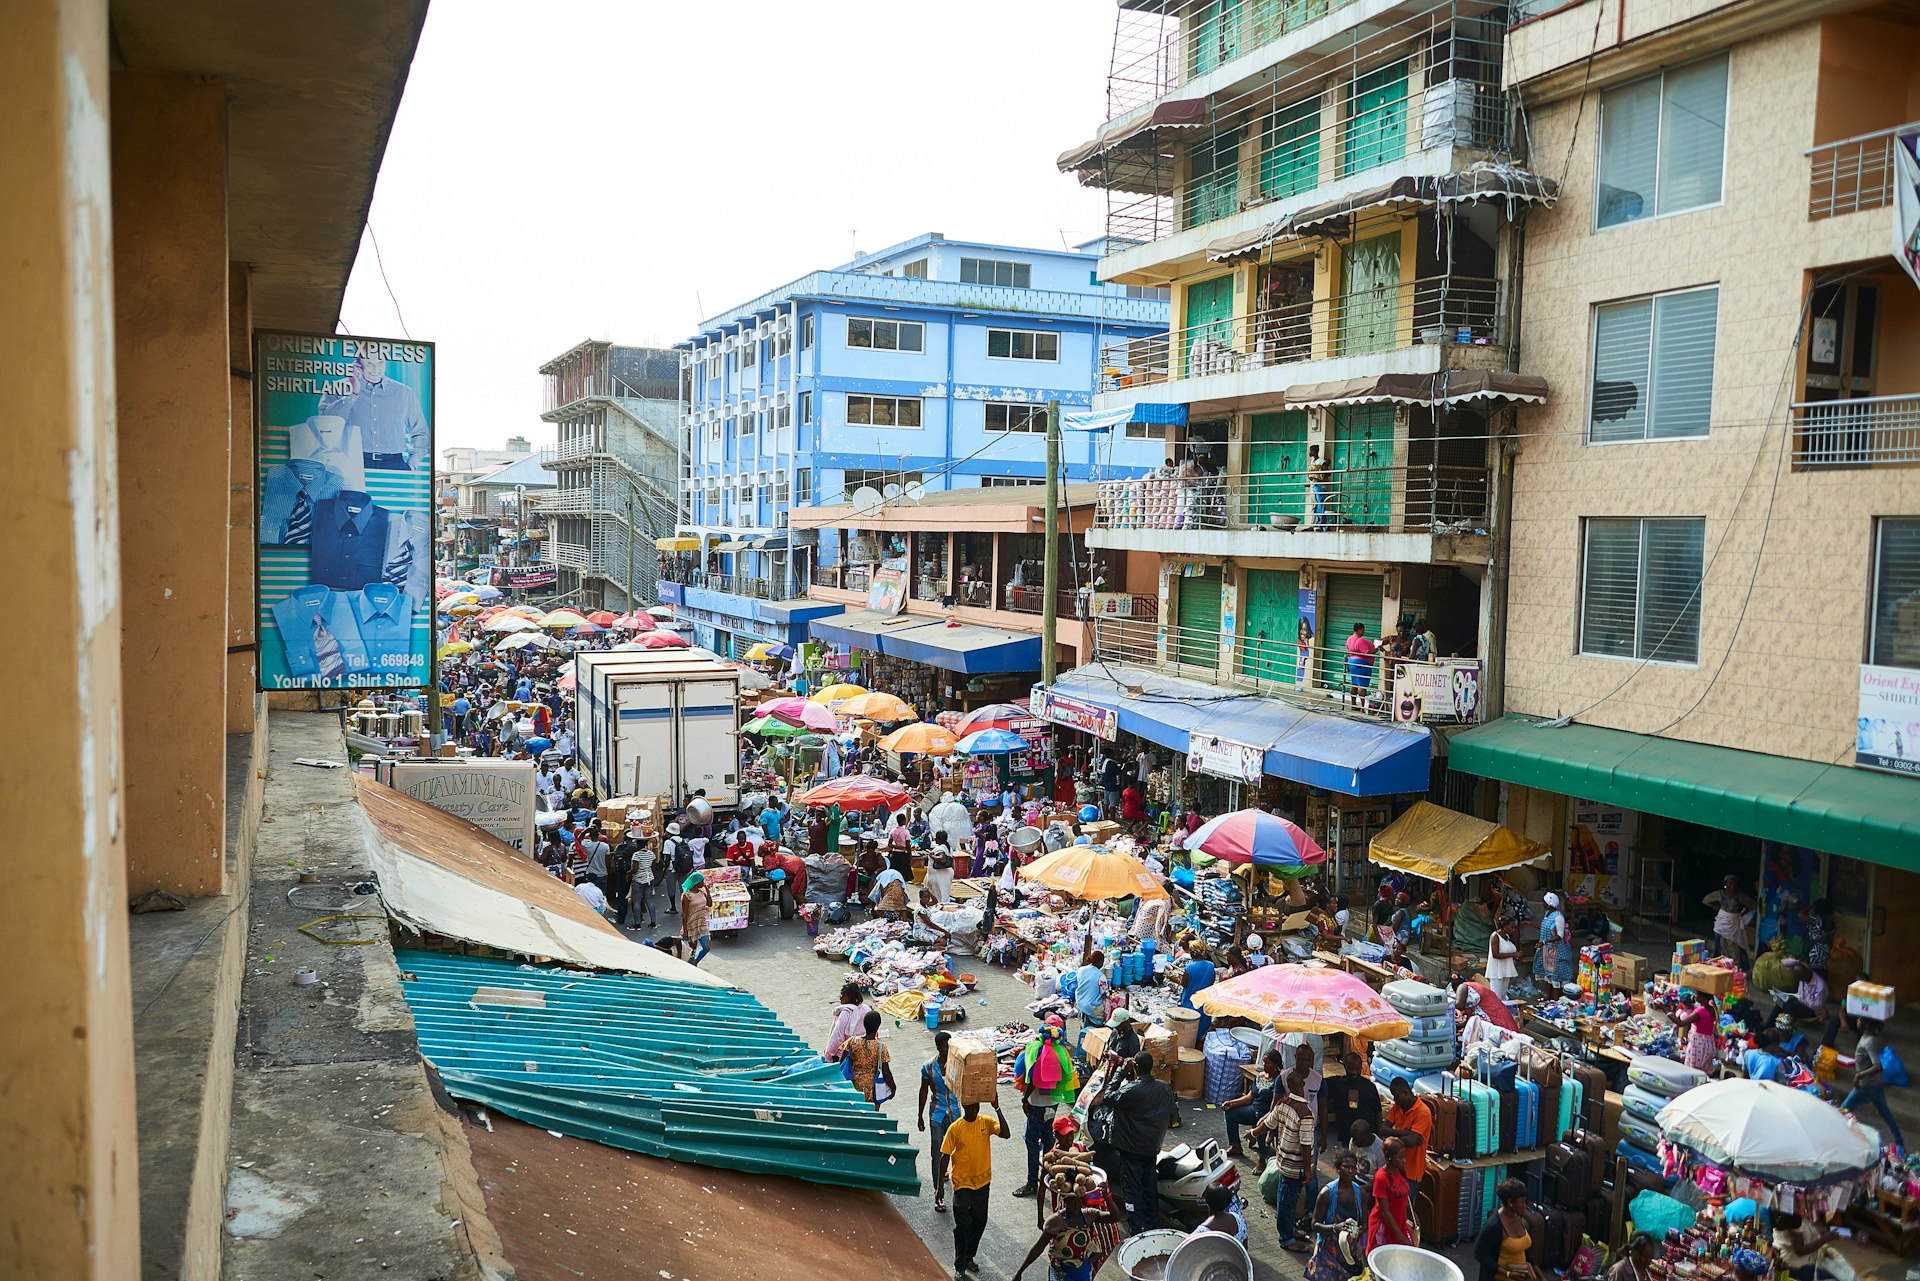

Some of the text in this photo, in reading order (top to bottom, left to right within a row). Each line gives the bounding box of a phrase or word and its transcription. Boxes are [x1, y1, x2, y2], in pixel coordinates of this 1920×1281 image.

[265, 334, 426, 364] ORIENT EXPRESS
[266, 357, 354, 377] ENTERPRISE
[266, 376, 354, 396] SHIRTLAND
[346, 653, 369, 667] Tel.
[380, 653, 425, 667] 669848
[273, 673, 421, 688] Your No 1 Shirt Shop
[1414, 673, 1448, 688] ROLINET
[1863, 671, 1898, 688] Orient
[1877, 757, 1889, 766] Tel
[477, 801, 510, 813] Care
